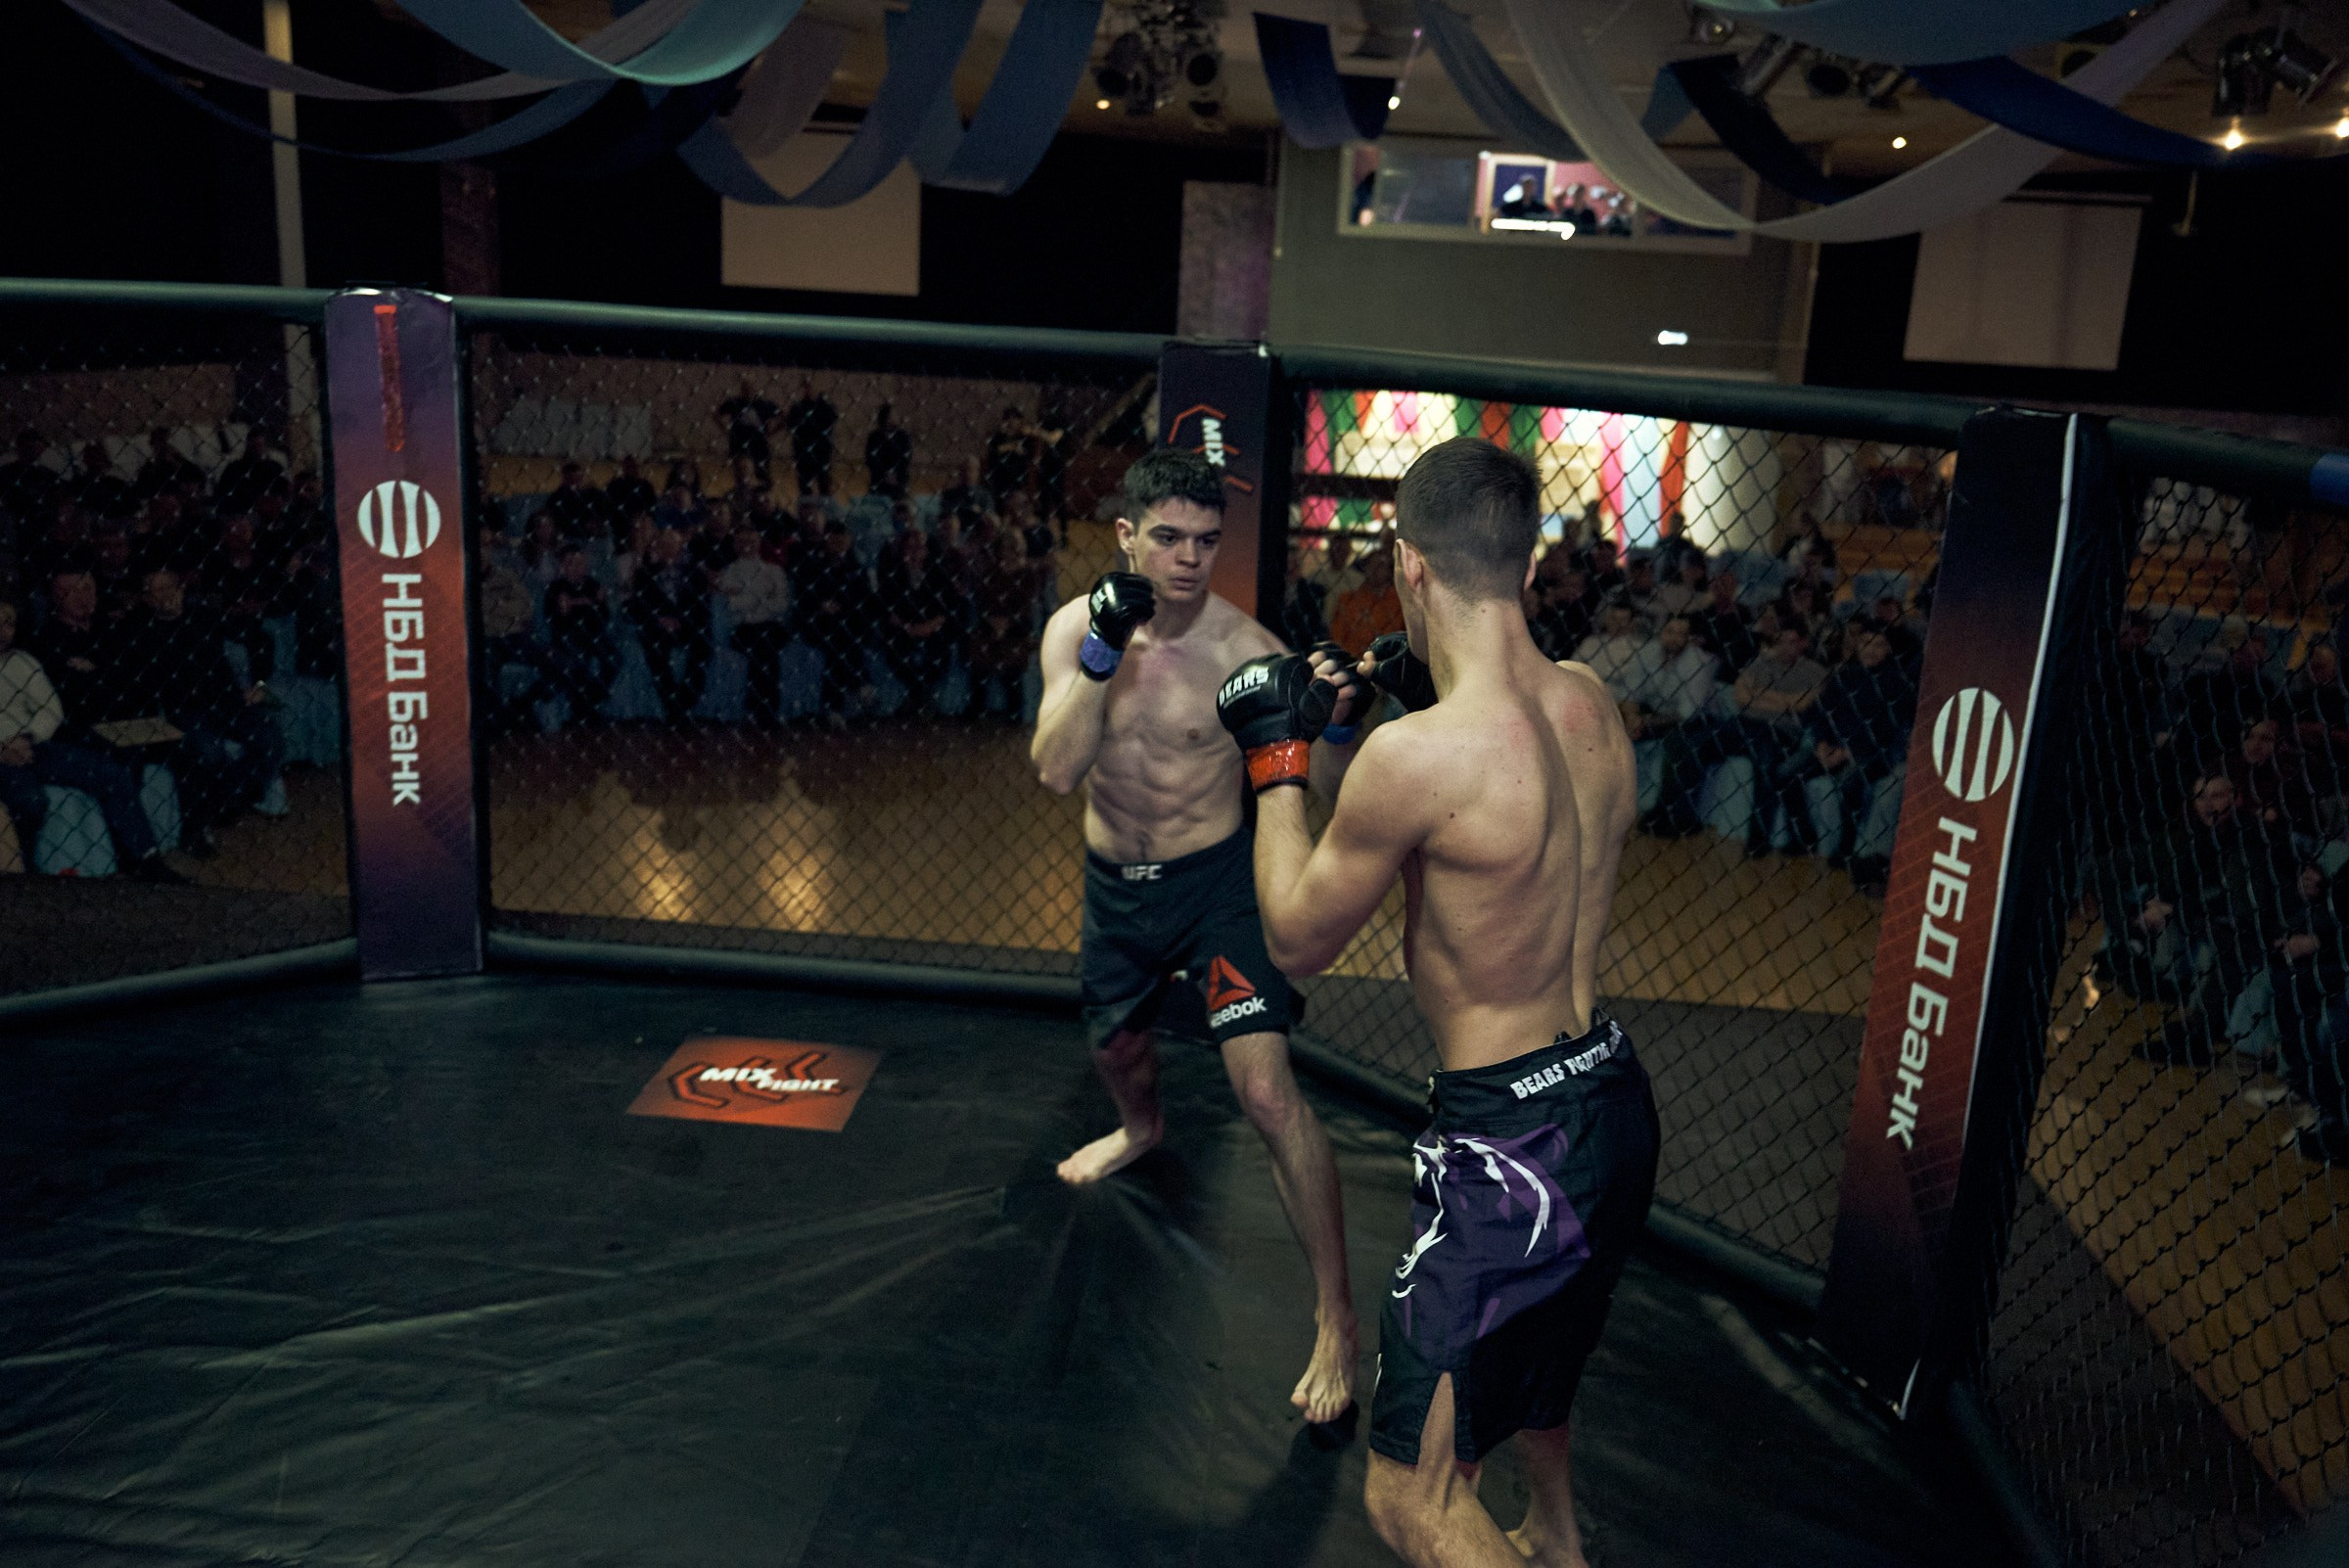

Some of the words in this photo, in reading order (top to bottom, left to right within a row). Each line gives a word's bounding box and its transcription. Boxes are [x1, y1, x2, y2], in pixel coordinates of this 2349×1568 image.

[1201, 418, 1226, 467] MIX
[381, 574, 427, 682] НБД
[388, 691, 429, 806] Банк
[1121, 863, 1164, 881] UFC
[1914, 815, 1978, 979] НБД
[1210, 996, 1268, 1030] eebok
[699, 1067, 778, 1083] MIX
[1509, 1063, 1566, 1100] BEARS
[1886, 982, 1950, 1151] Банк
